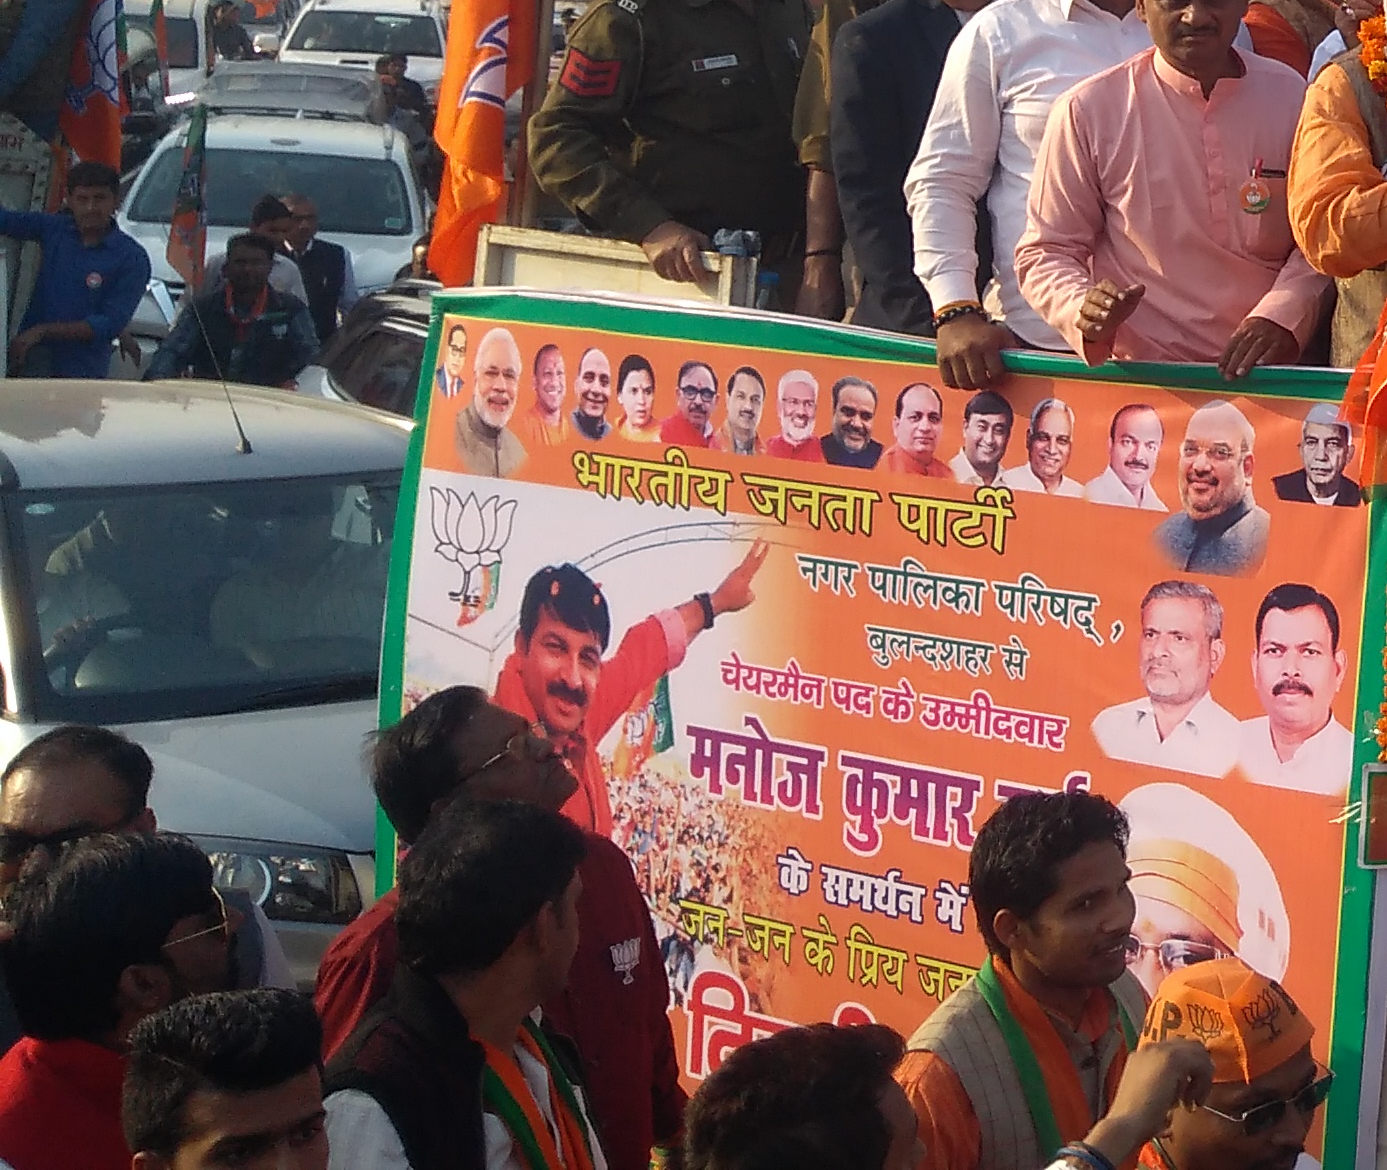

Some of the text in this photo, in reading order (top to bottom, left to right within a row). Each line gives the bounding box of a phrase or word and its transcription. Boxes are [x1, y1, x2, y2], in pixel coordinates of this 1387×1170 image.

[572, 446, 1015, 555] भारतीय जनता पार्टी
[796, 552, 860, 596] नगर
[868, 557, 986, 617] पालिका
[865, 624, 1031, 681] बुलन्दशहर से
[831, 679, 876, 718] पद
[879, 678, 917, 723] के
[919, 691, 1070, 753] उम्मीदवार
[686, 716, 984, 858] मनोज कुमार
[776, 847, 970, 933] के समर्थन में
[678, 898, 796, 966] जन-जन
[802, 914, 839, 975] के
[846, 923, 909, 994] प्रिय
